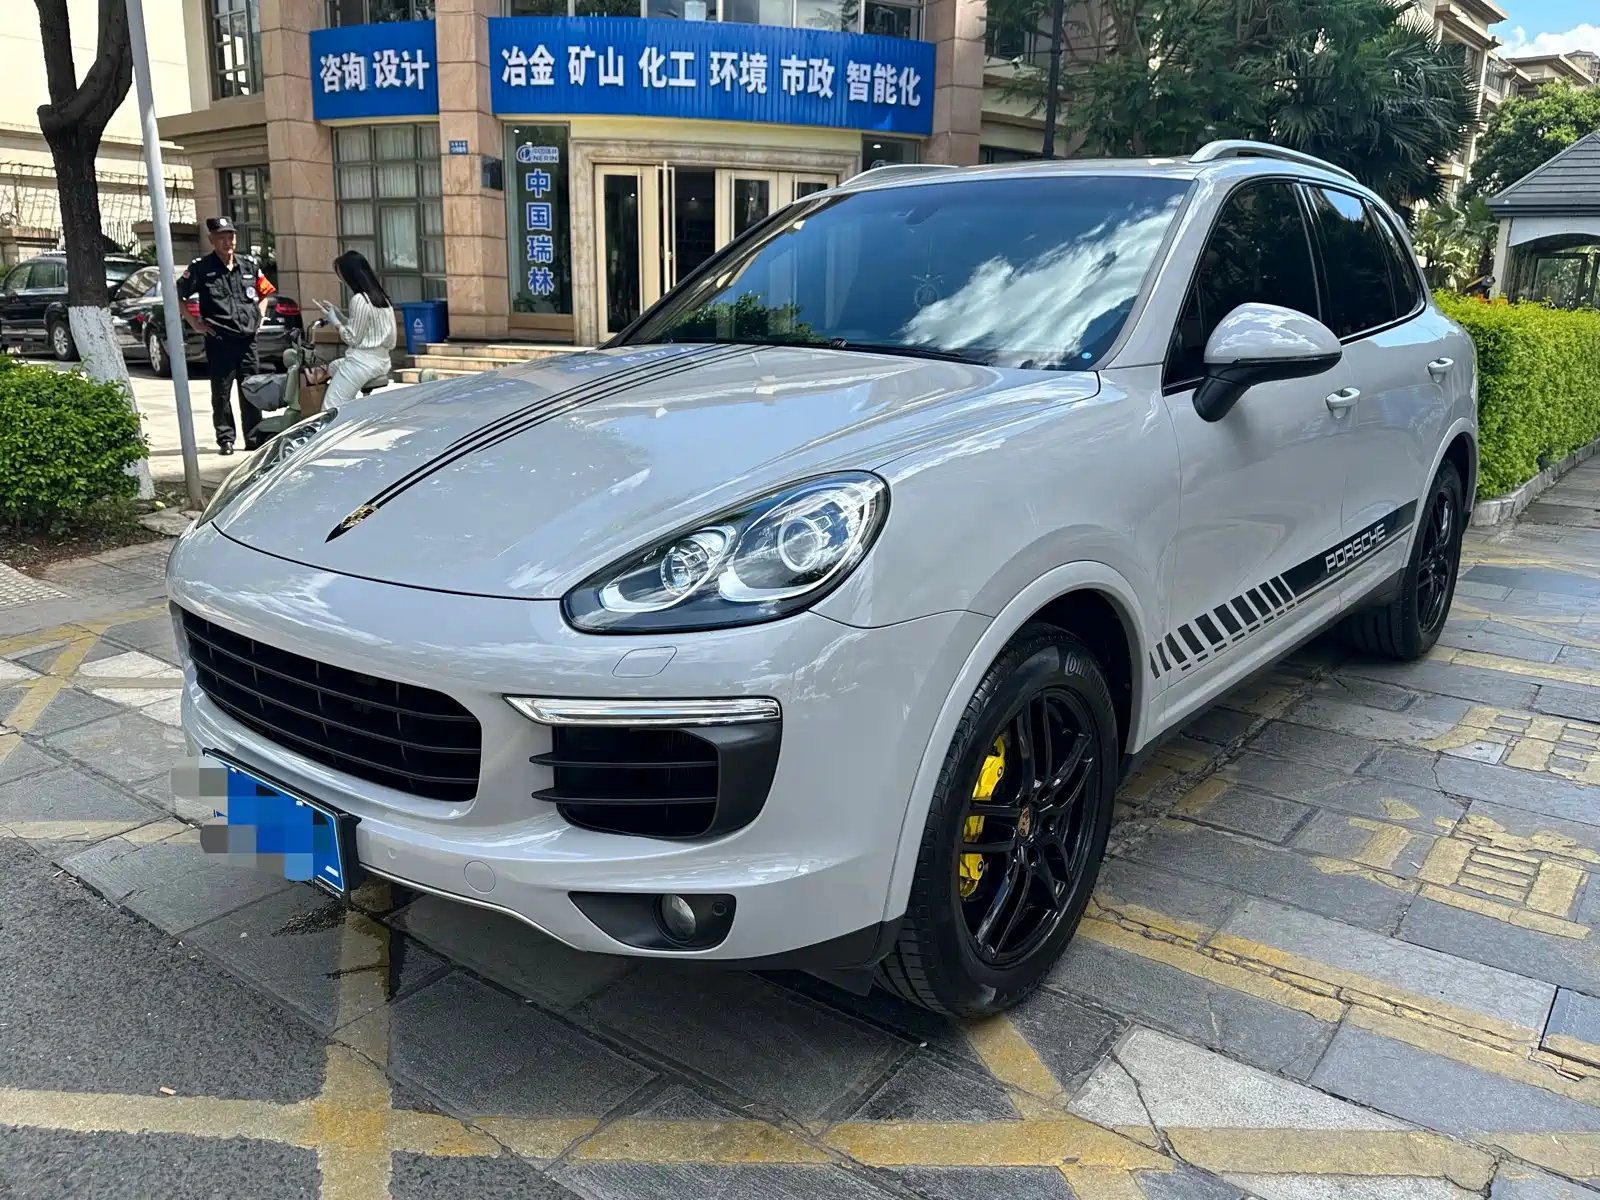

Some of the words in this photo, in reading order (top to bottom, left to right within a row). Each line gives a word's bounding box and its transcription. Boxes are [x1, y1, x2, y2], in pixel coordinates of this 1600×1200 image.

[319, 52, 366, 93] 咨询
[372, 49, 430, 90] 设计
[501, 44, 555, 87] 冶金
[567, 45, 624, 87] 矿山
[638, 46, 696, 88] 化工
[709, 51, 768, 94] 环境
[780, 54, 835, 99] 市政
[846, 60, 921, 107] 智能化
[525, 168, 554, 296] 中国瑞林
[1325, 523, 1386, 574] PORSCHE
